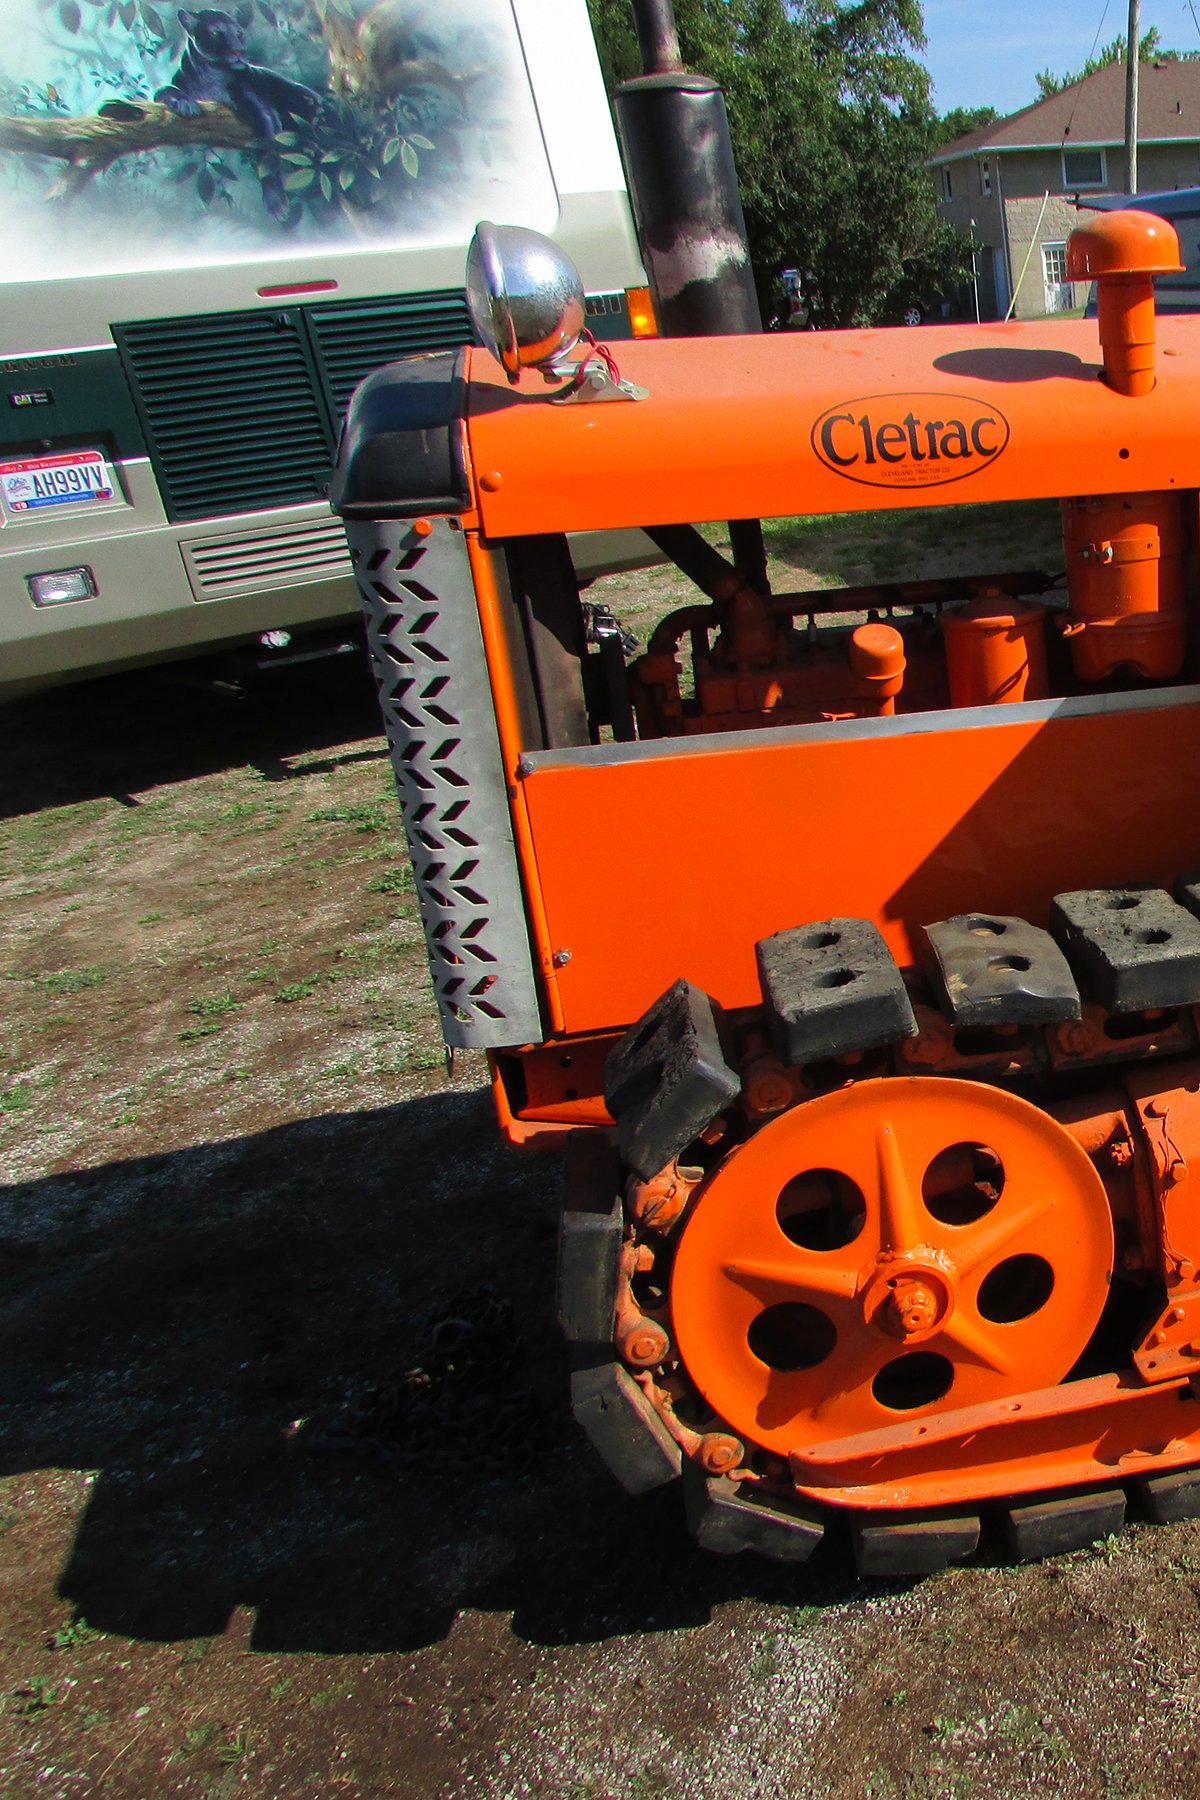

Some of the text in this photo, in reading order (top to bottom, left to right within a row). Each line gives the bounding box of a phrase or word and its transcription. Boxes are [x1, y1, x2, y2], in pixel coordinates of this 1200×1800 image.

[584, 294, 622, 317] RI
[14, 394, 33, 406] CAT
[821, 412, 998, 466] Cletrac
[32, 465, 104, 498] AH99VV
